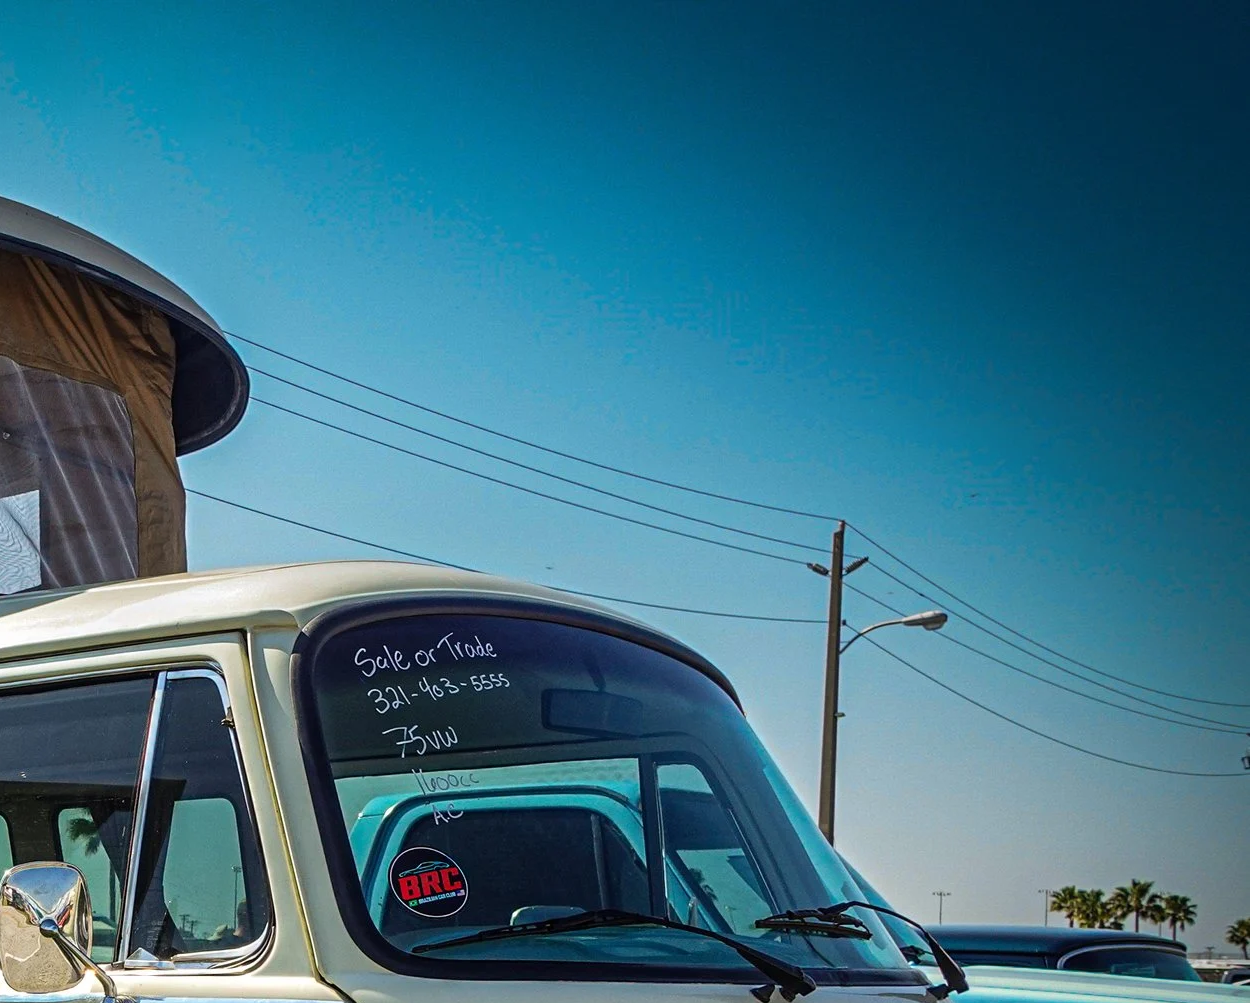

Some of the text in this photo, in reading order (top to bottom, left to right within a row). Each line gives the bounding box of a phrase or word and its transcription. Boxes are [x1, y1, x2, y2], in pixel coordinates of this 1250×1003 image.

[354, 632, 497, 677] Sale or Trade
[398, 867, 462, 900] BRC
